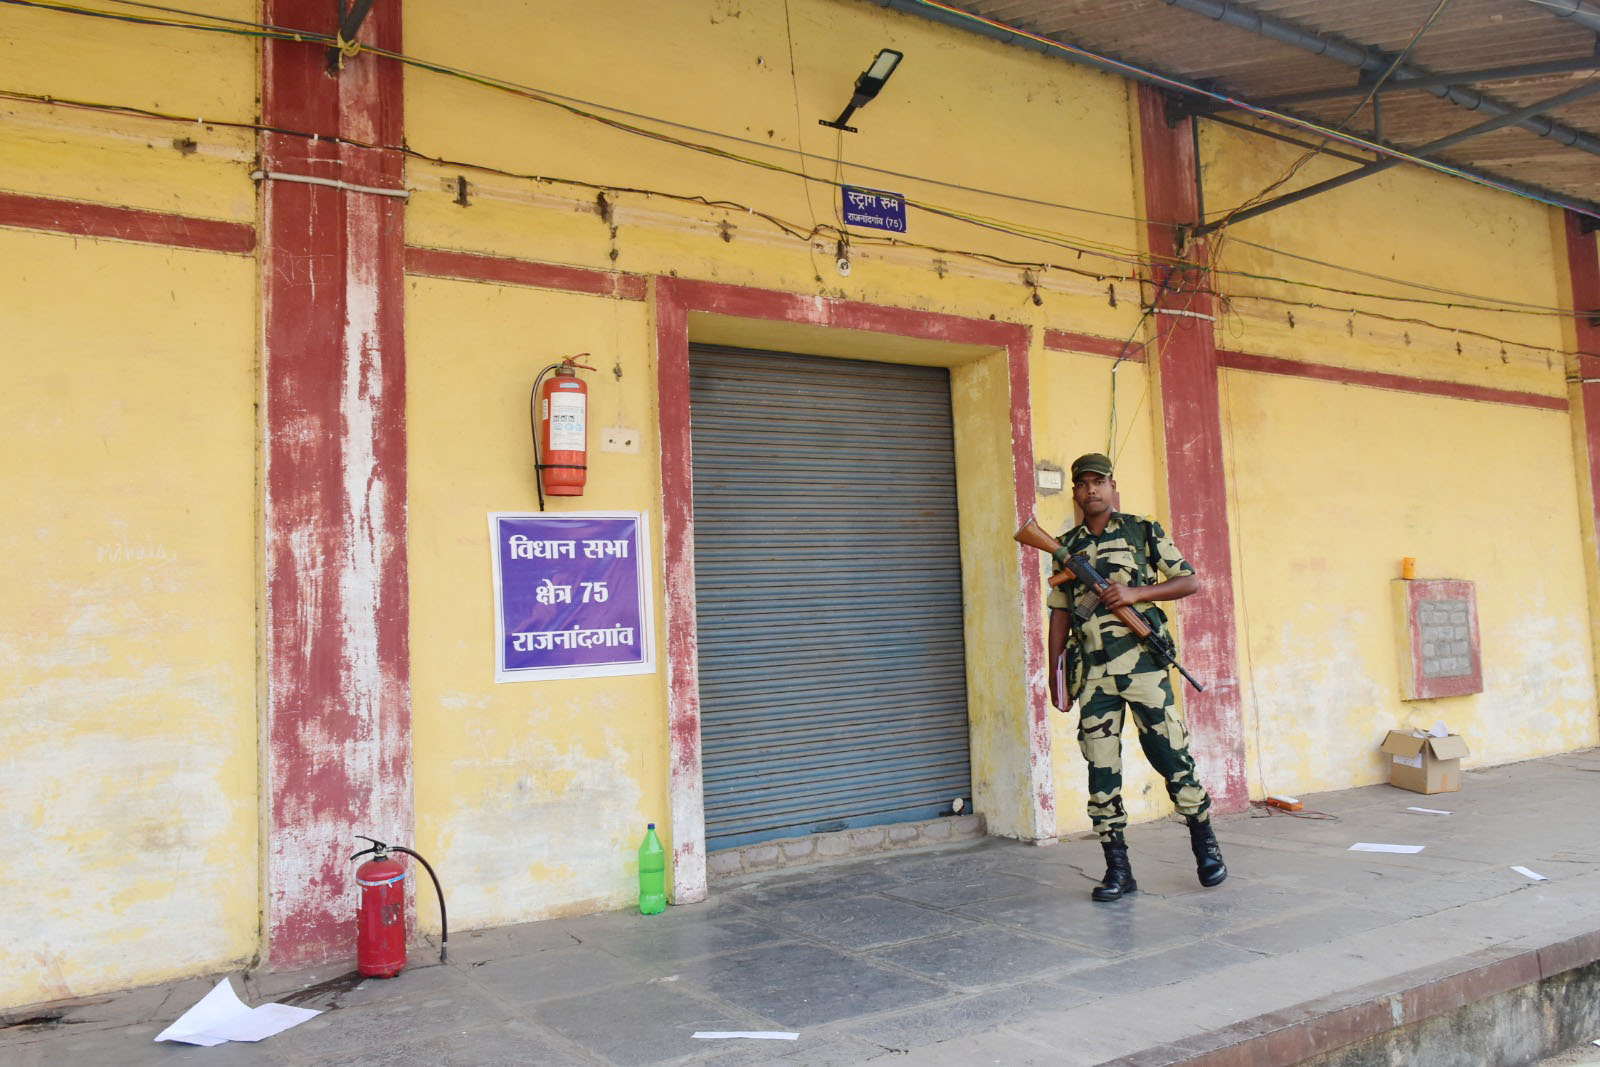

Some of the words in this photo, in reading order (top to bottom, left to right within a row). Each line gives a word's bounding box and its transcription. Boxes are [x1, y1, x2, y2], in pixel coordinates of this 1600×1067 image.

[847, 213, 883, 226] राजनांदगांव
[885, 216, 903, 231] (75)
[508, 535, 576, 559] विधान
[582, 540, 628, 558] सभा
[536, 578, 572, 605] क्षेत्र
[580, 583, 609, 603] 75
[511, 623, 634, 652] राजनांदगांव
